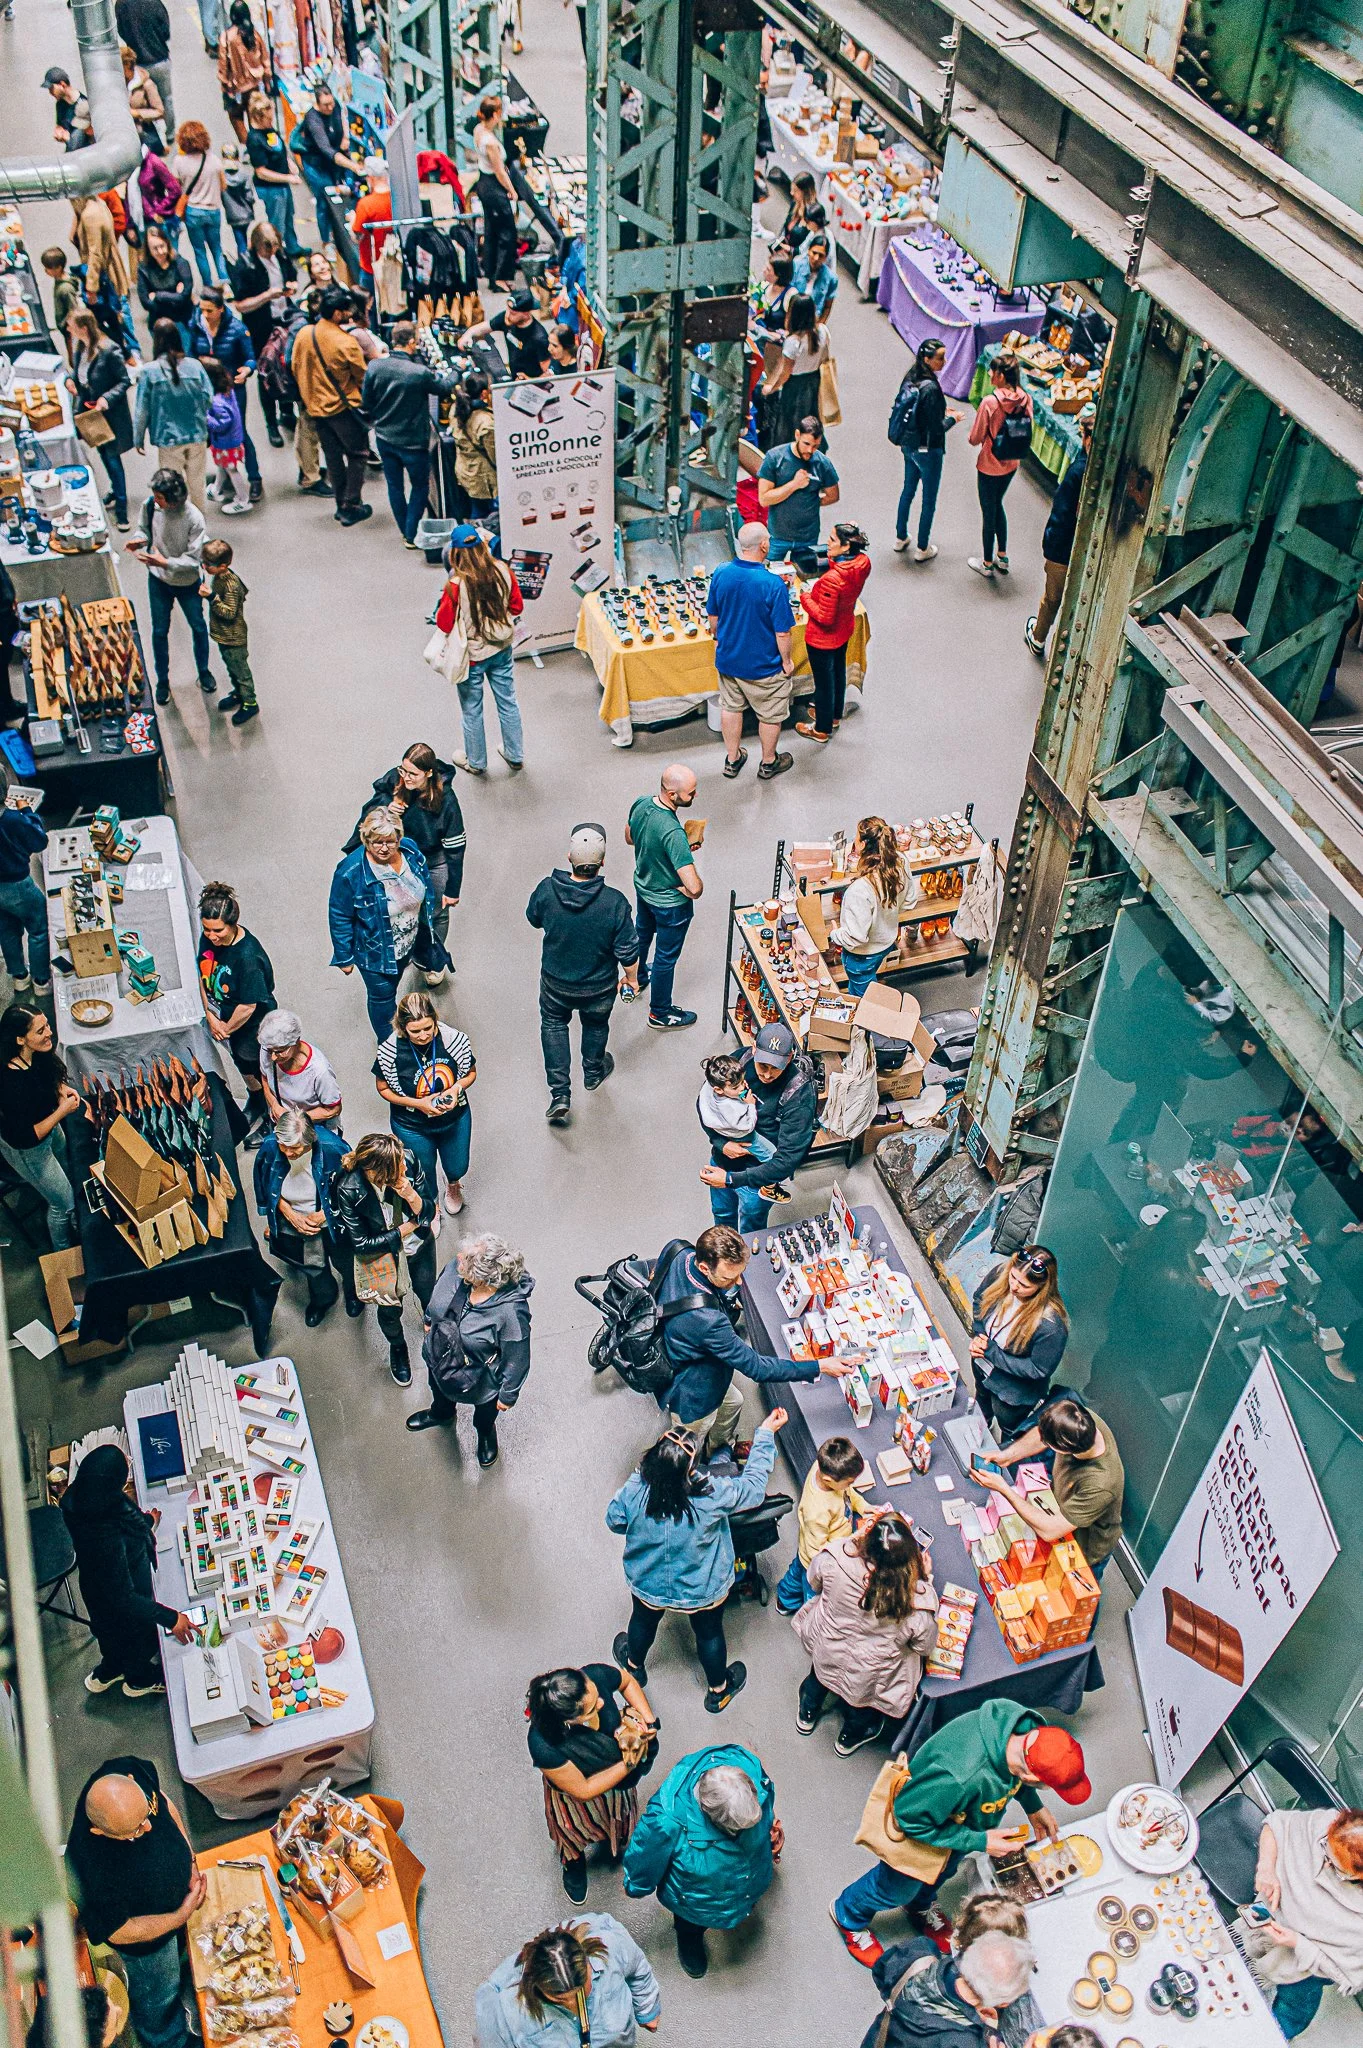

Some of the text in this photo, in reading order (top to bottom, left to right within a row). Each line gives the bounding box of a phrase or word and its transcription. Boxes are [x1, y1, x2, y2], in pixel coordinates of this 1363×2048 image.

[509, 428, 549, 445] allo
[512, 435, 602, 460] simonne
[512, 460, 554, 472] TARTINADES
[563, 453, 602, 464] CHOCOLAT
[516, 469, 546, 479] SPREADS
[556, 461, 599, 473] CHOCOLATE
[1205, 1480, 1241, 1590] chocolate bar
[1211, 1466, 1243, 1569] This is not a
[1218, 1454, 1272, 1615] de chocolat
[1225, 1439, 1268, 1574] une barre
[1233, 1424, 1257, 1484] Ceci
[1270, 1554, 1297, 1609] pas
